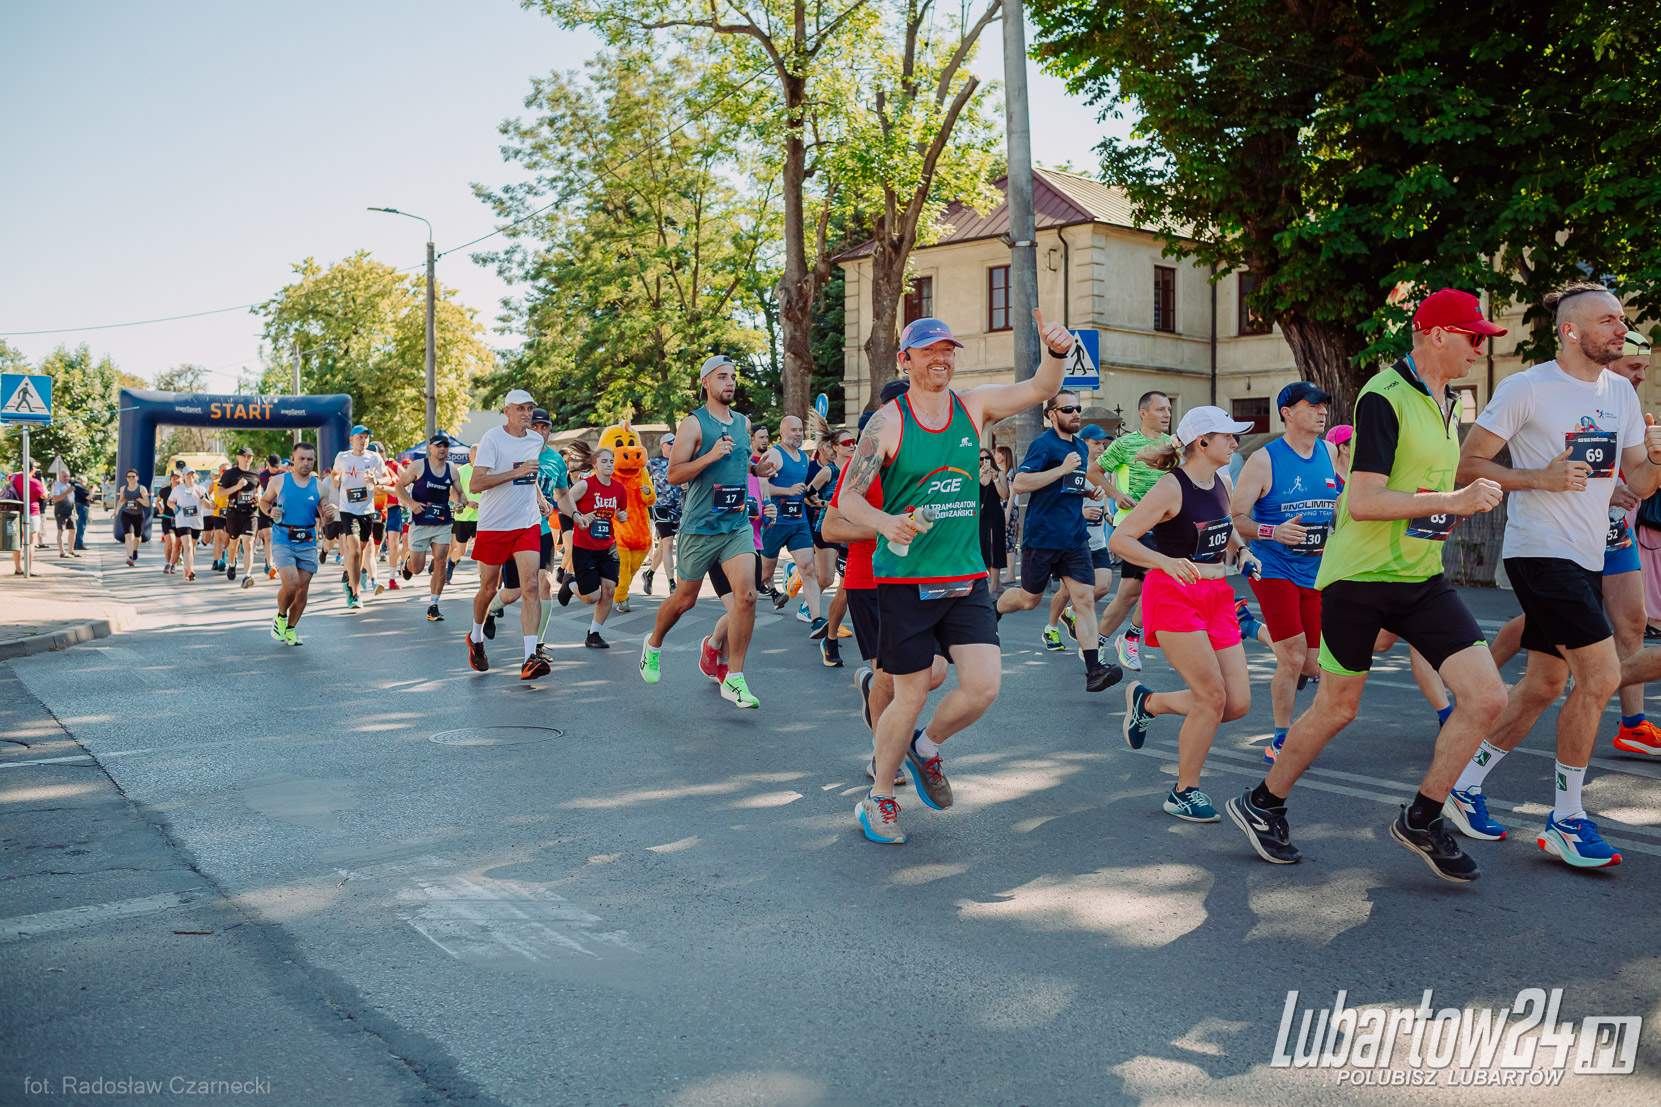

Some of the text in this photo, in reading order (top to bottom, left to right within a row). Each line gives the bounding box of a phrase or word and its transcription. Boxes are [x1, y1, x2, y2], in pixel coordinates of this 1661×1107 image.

[210, 402, 274, 420] START
[1585, 448, 1604, 462] 69
[928, 478, 962, 494] PGE
[1074, 476, 1084, 485] 67
[726, 495, 737, 503] 17
[1208, 532, 1227, 547] 105
[1607, 529, 1618, 540] 52
